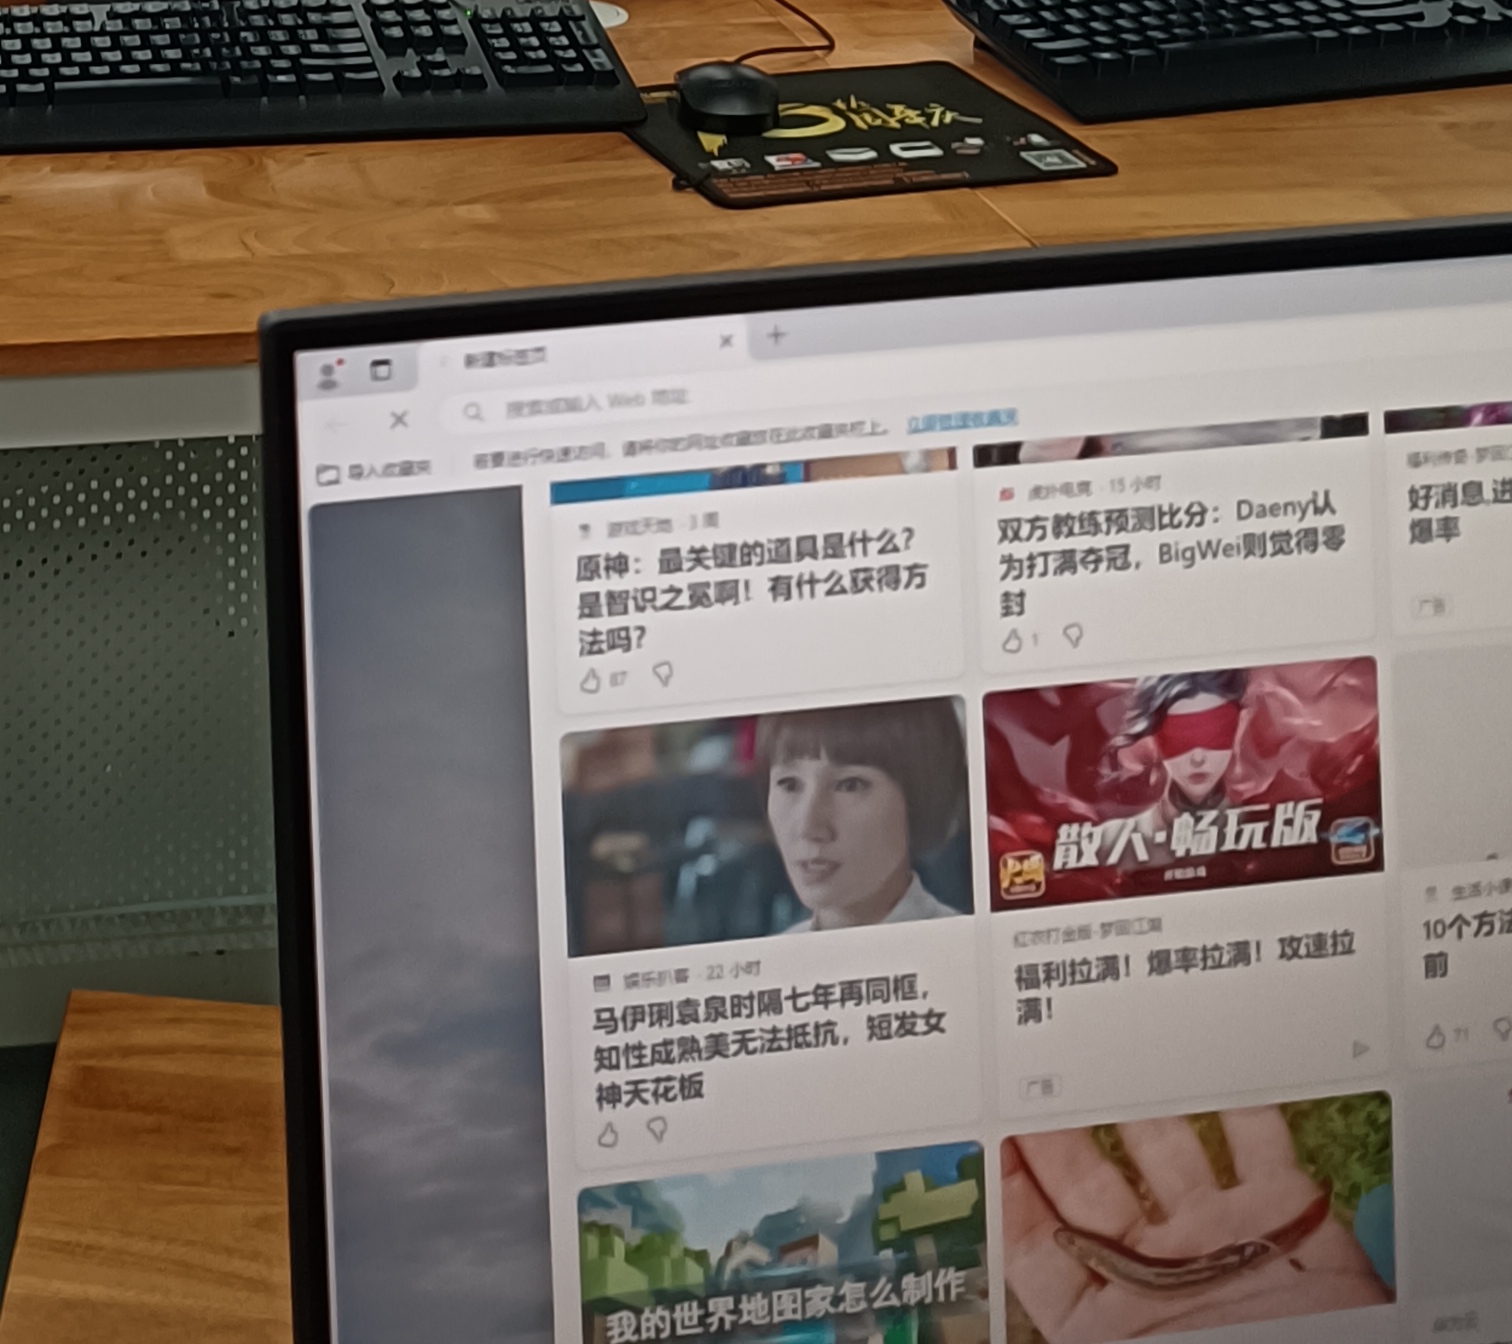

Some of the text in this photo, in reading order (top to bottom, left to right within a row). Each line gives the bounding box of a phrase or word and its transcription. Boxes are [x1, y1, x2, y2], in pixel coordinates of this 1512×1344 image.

[1000, 588, 1026, 619] 封
[1052, 798, 1324, 871] 散人·畅玩版
[729, 959, 762, 978] 小时
[596, 1072, 705, 1112] 神天花板
